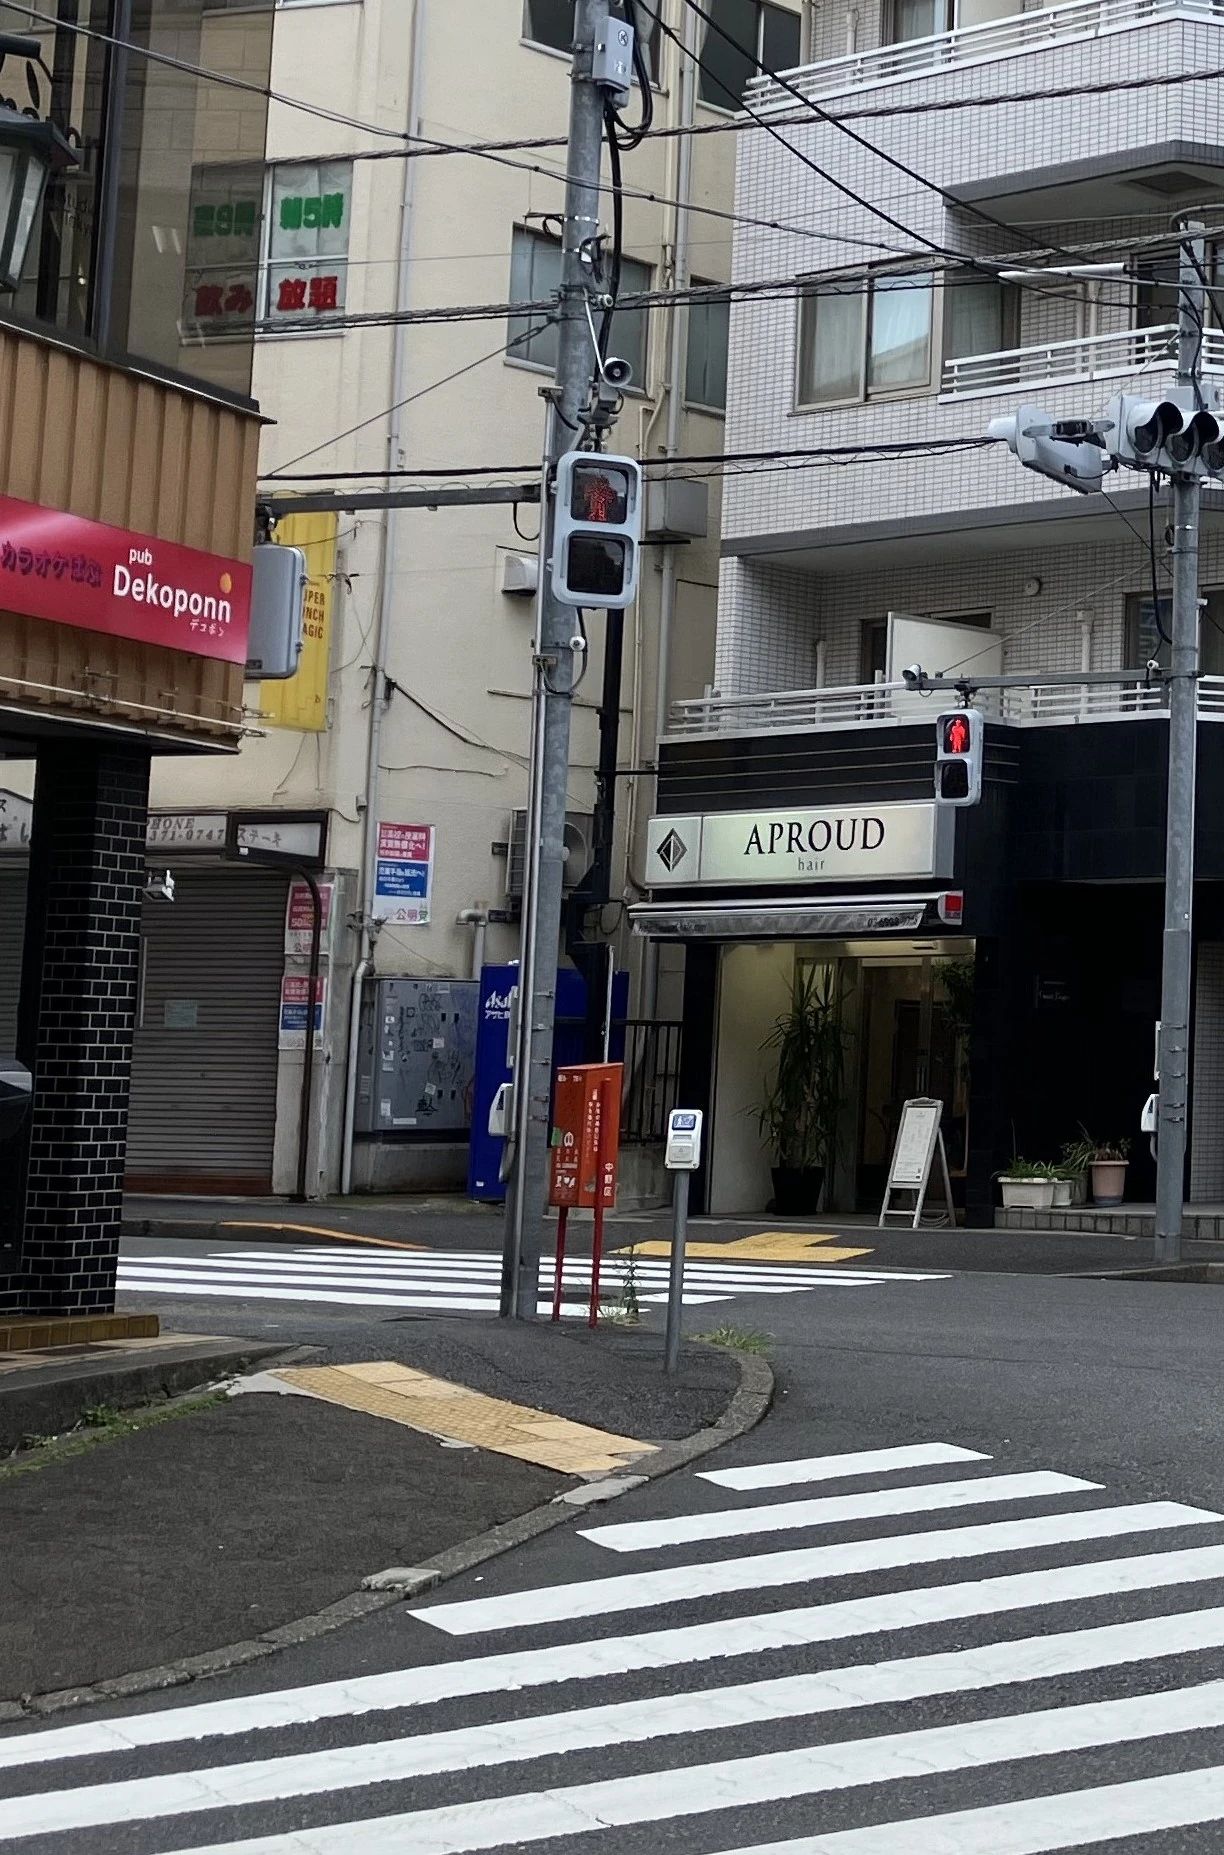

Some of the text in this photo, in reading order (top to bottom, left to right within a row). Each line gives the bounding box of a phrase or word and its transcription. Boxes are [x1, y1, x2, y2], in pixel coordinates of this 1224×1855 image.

[129, 548, 153, 566] pub
[113, 564, 232, 624] Dekoponn
[744, 817, 885, 855] APROUD
[798, 858, 825, 871] hair
